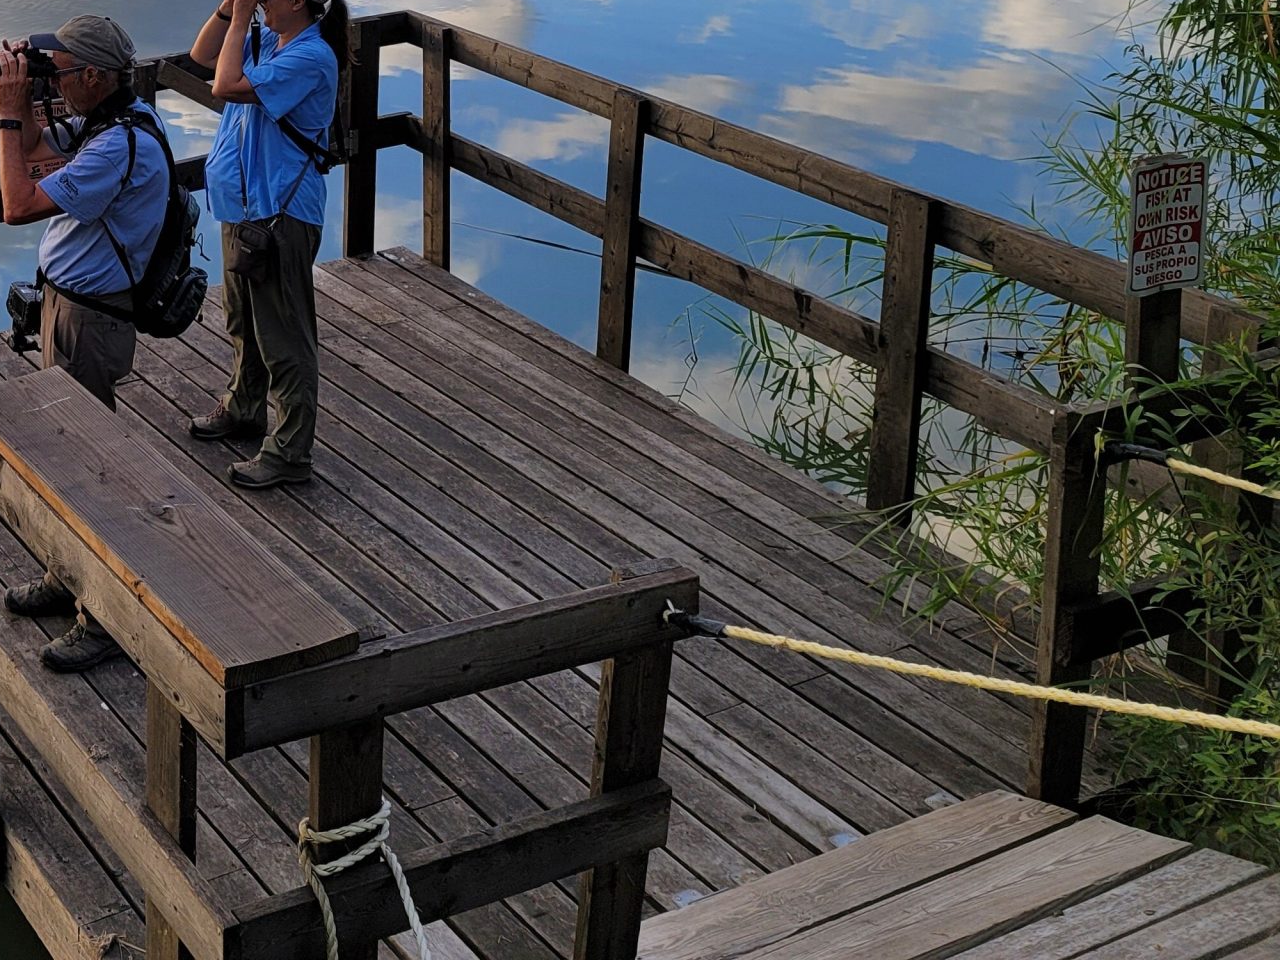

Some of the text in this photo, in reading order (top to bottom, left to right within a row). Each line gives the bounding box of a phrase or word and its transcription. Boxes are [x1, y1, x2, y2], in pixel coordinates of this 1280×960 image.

[1138, 165, 1202, 191] NOTICE
[1146, 188, 1192, 209] FISH AT
[1138, 205, 1198, 228] OWN RISK
[1141, 225, 1192, 249] AVISO
[1145, 245, 1186, 261] PESCA A
[1135, 256, 1196, 276] SUS PROPIO
[1146, 269, 1182, 286] RIESGO
